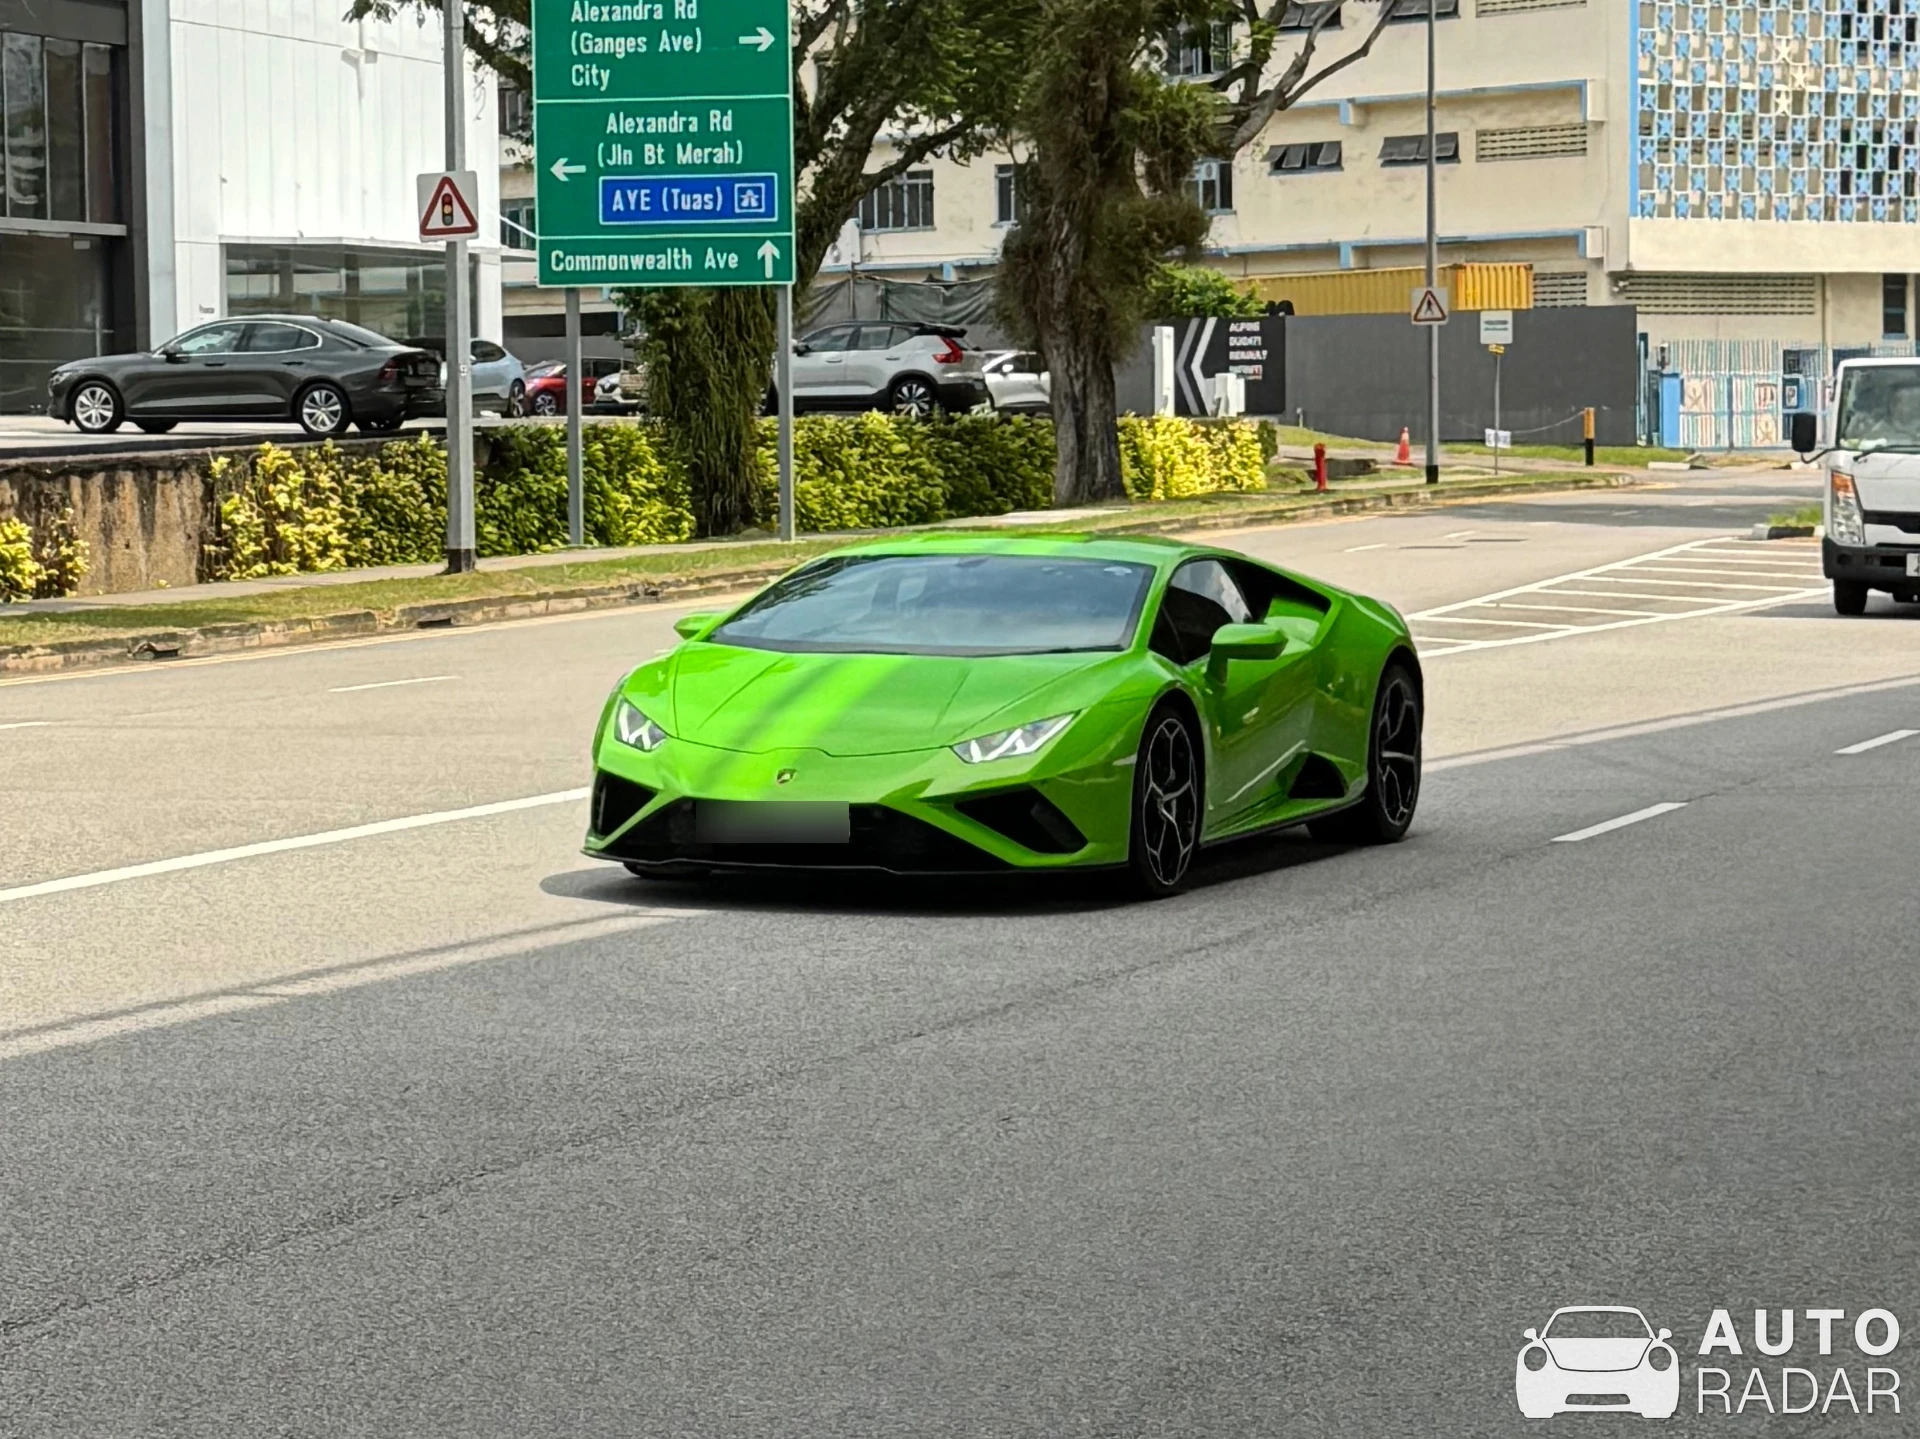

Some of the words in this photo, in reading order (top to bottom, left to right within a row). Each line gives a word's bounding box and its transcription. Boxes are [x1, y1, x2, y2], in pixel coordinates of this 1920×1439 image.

[571, 0, 663, 23] Alexandra
[674, 0, 697, 20] Rd
[571, 31, 647, 59] (Ganges
[658, 27, 702, 54] Ave)
[571, 64, 611, 91] City
[606, 111, 698, 134] Alexandra
[709, 109, 733, 132] Rd
[597, 142, 633, 168] (Jln
[644, 143, 665, 165] Bt
[676, 139, 743, 165] Merah)
[612, 189, 651, 212] AYE
[662, 186, 723, 212] (Tuas)
[550, 247, 692, 272] Commonwealth
[704, 247, 739, 270] Ave
